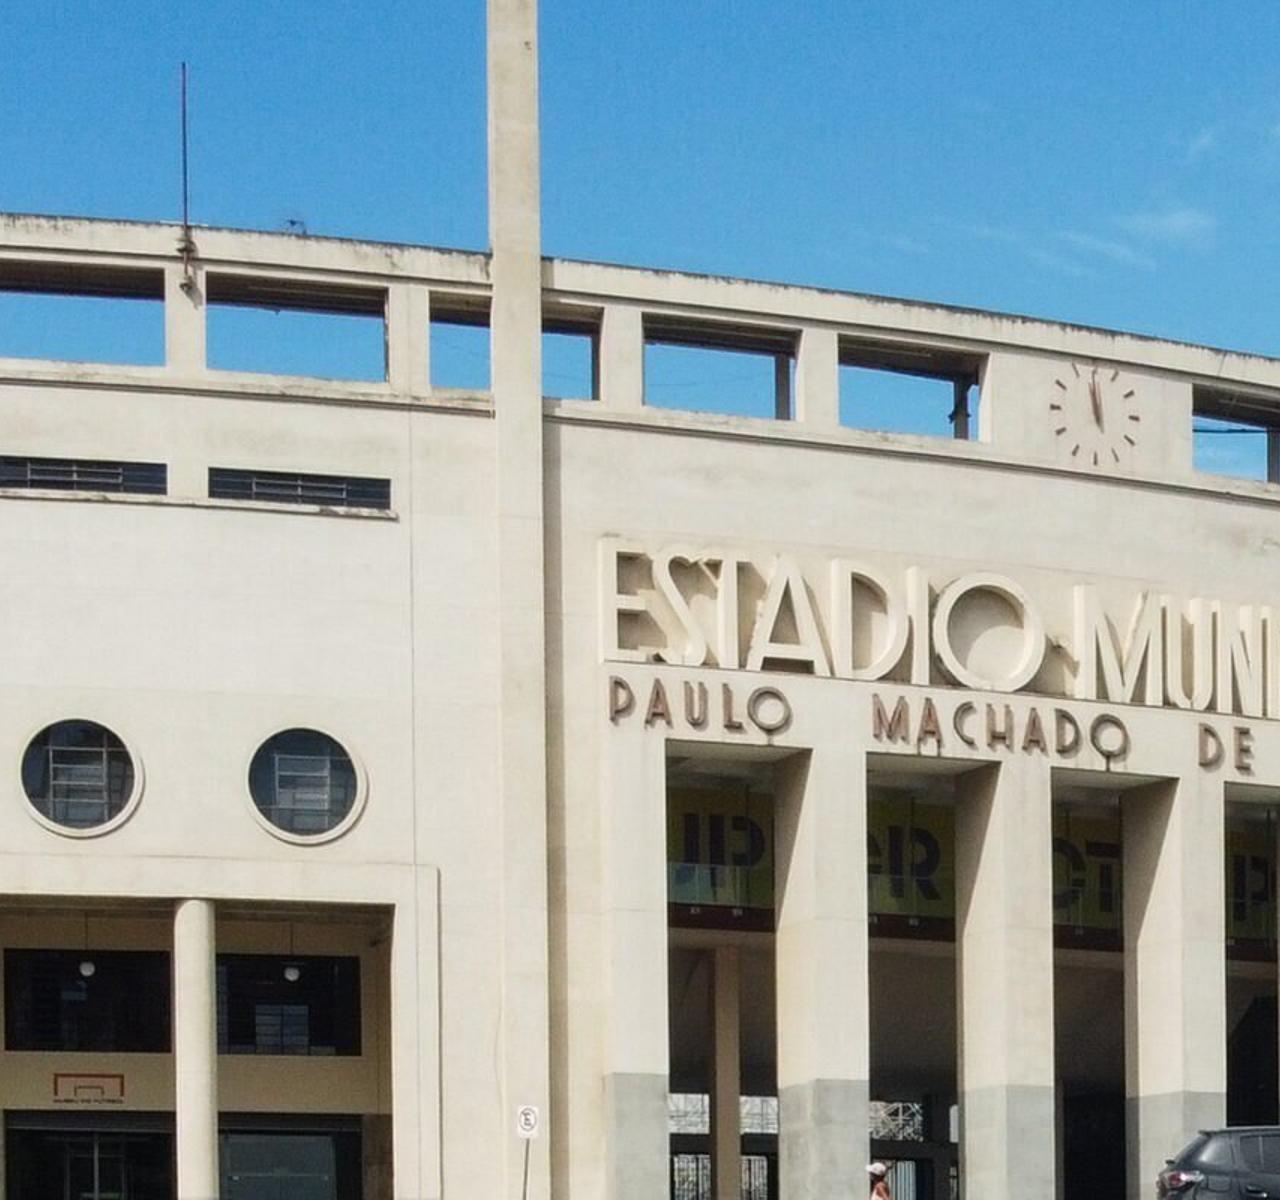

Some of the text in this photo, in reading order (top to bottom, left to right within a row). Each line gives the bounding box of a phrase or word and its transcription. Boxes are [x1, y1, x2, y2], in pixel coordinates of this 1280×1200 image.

[600, 536, 1046, 692] ESTADIO
[609, 675, 792, 735] PAULO
[872, 693, 1130, 763] MACHADO
[1198, 722, 1254, 775] DE
